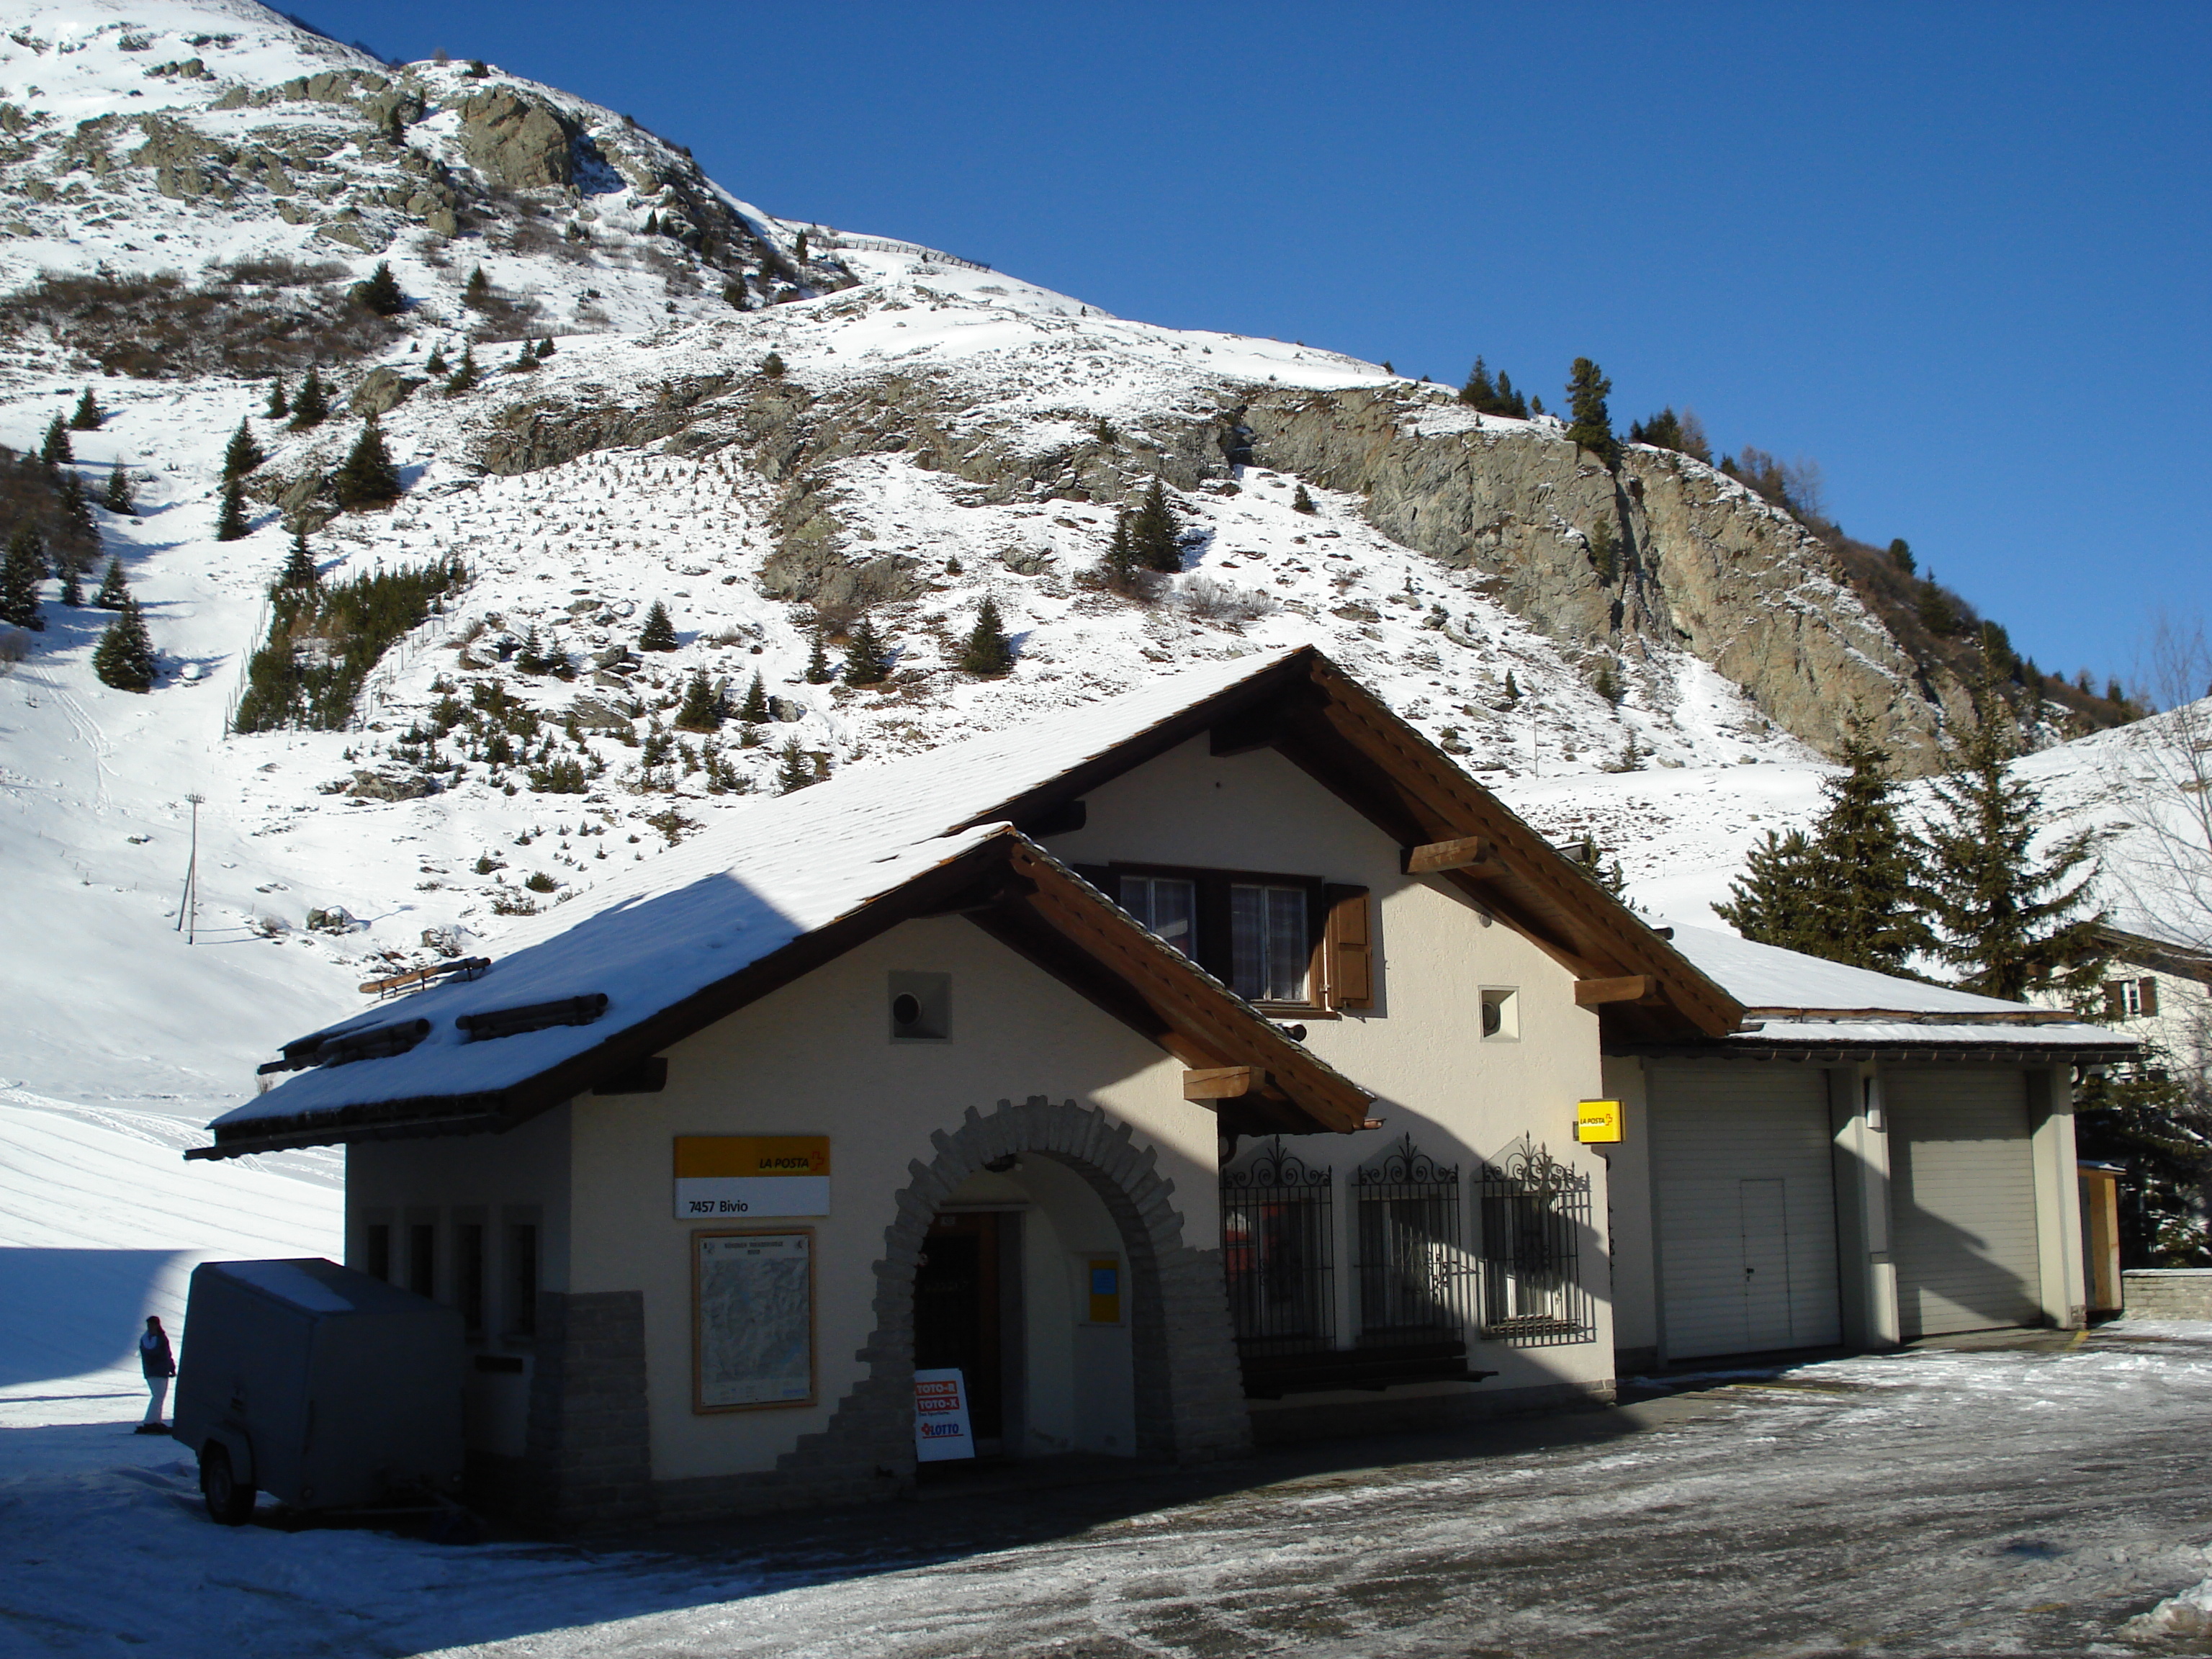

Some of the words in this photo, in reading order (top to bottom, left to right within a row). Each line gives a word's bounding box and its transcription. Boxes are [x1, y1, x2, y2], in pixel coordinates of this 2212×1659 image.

[760, 1159, 772, 1169] LA
[775, 1158, 809, 1169] POSTA
[689, 1201, 715, 1213] 7457
[719, 1200, 748, 1213] Bivio
[917, 1383, 956, 1393] TOTO-R
[919, 1398, 958, 1409] TOTO-X
[931, 1424, 959, 1435] LOTTO
